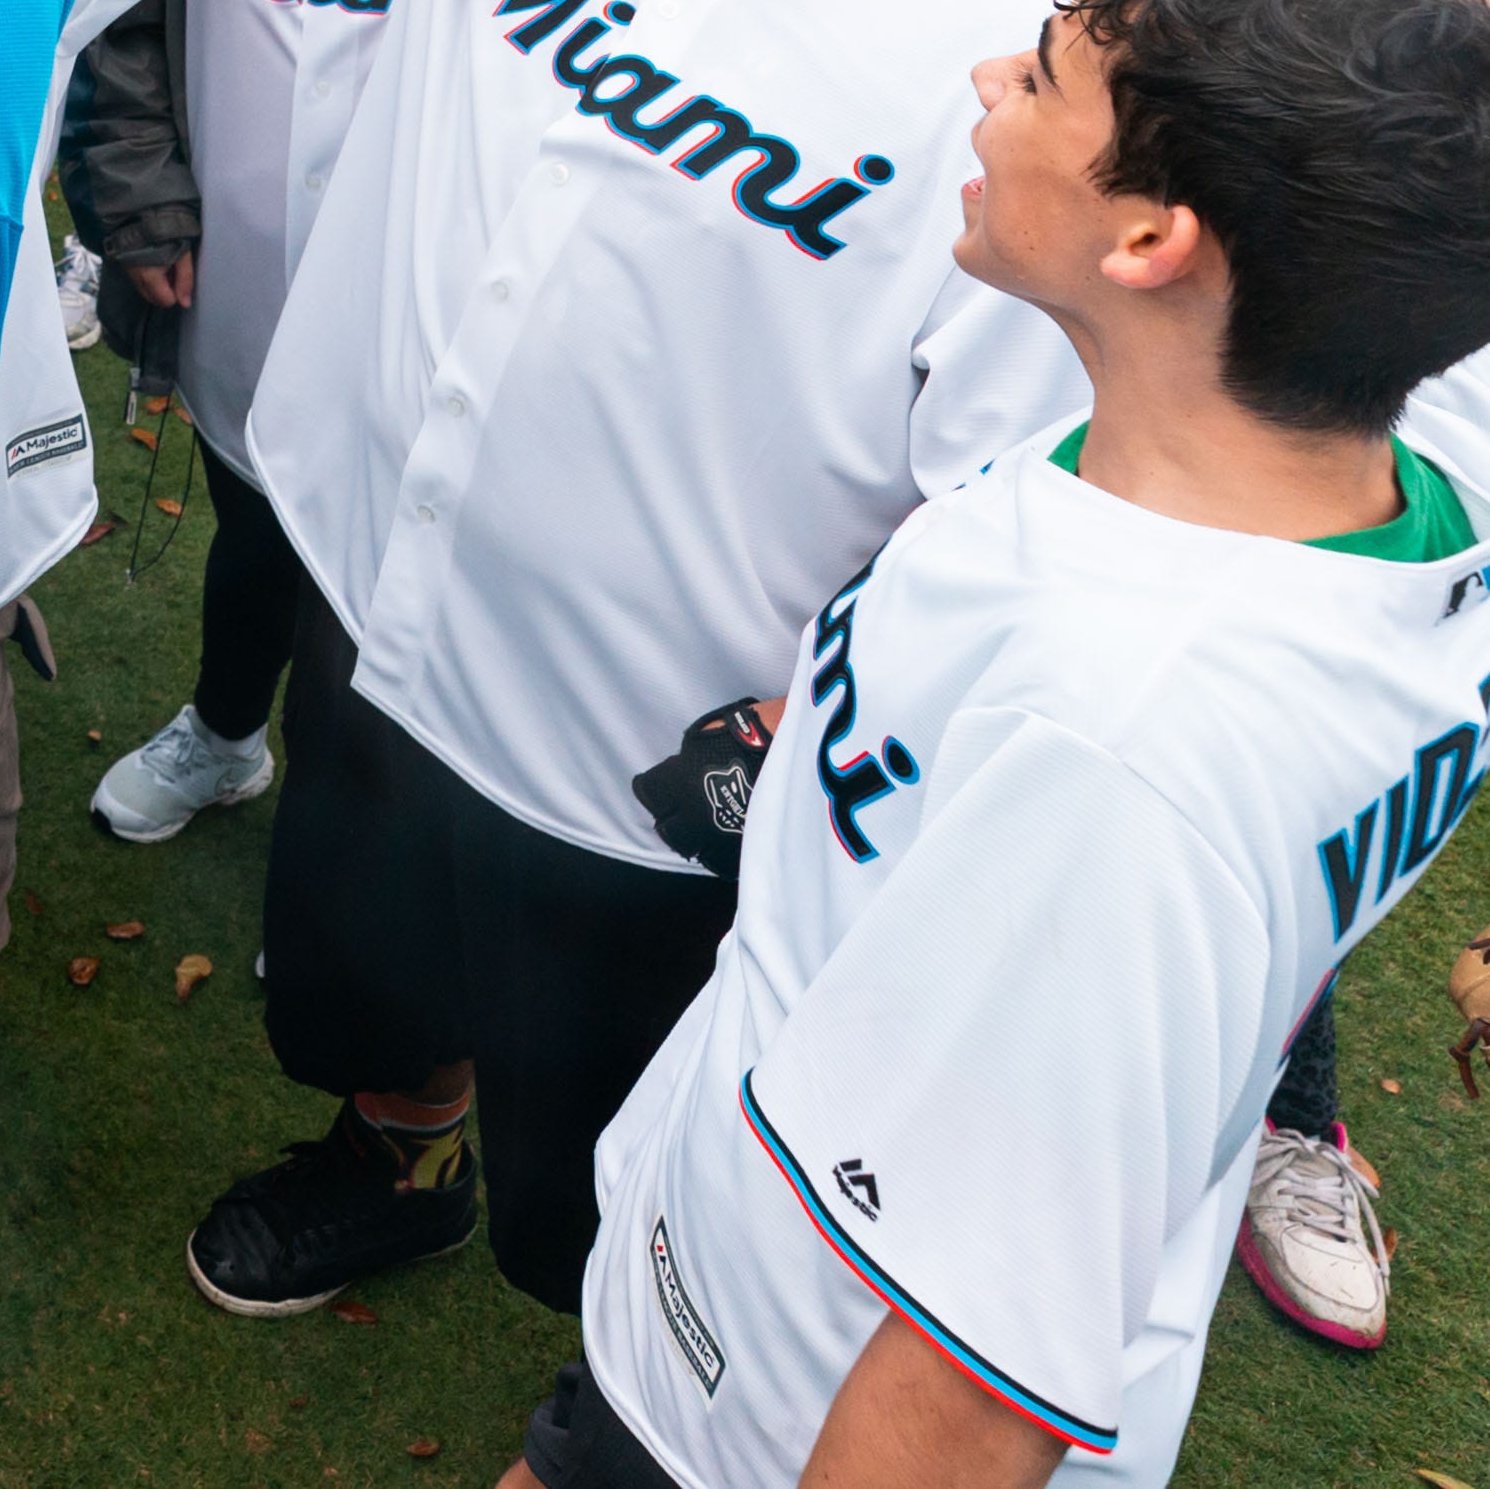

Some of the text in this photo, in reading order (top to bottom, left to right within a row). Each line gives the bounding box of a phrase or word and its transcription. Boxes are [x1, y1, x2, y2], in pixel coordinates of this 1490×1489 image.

[26, 426, 79, 451] Majestic
[1317, 673, 1490, 944] VID
[831, 1164, 878, 1223] Majestic
[665, 1270, 715, 1369] Majestic
